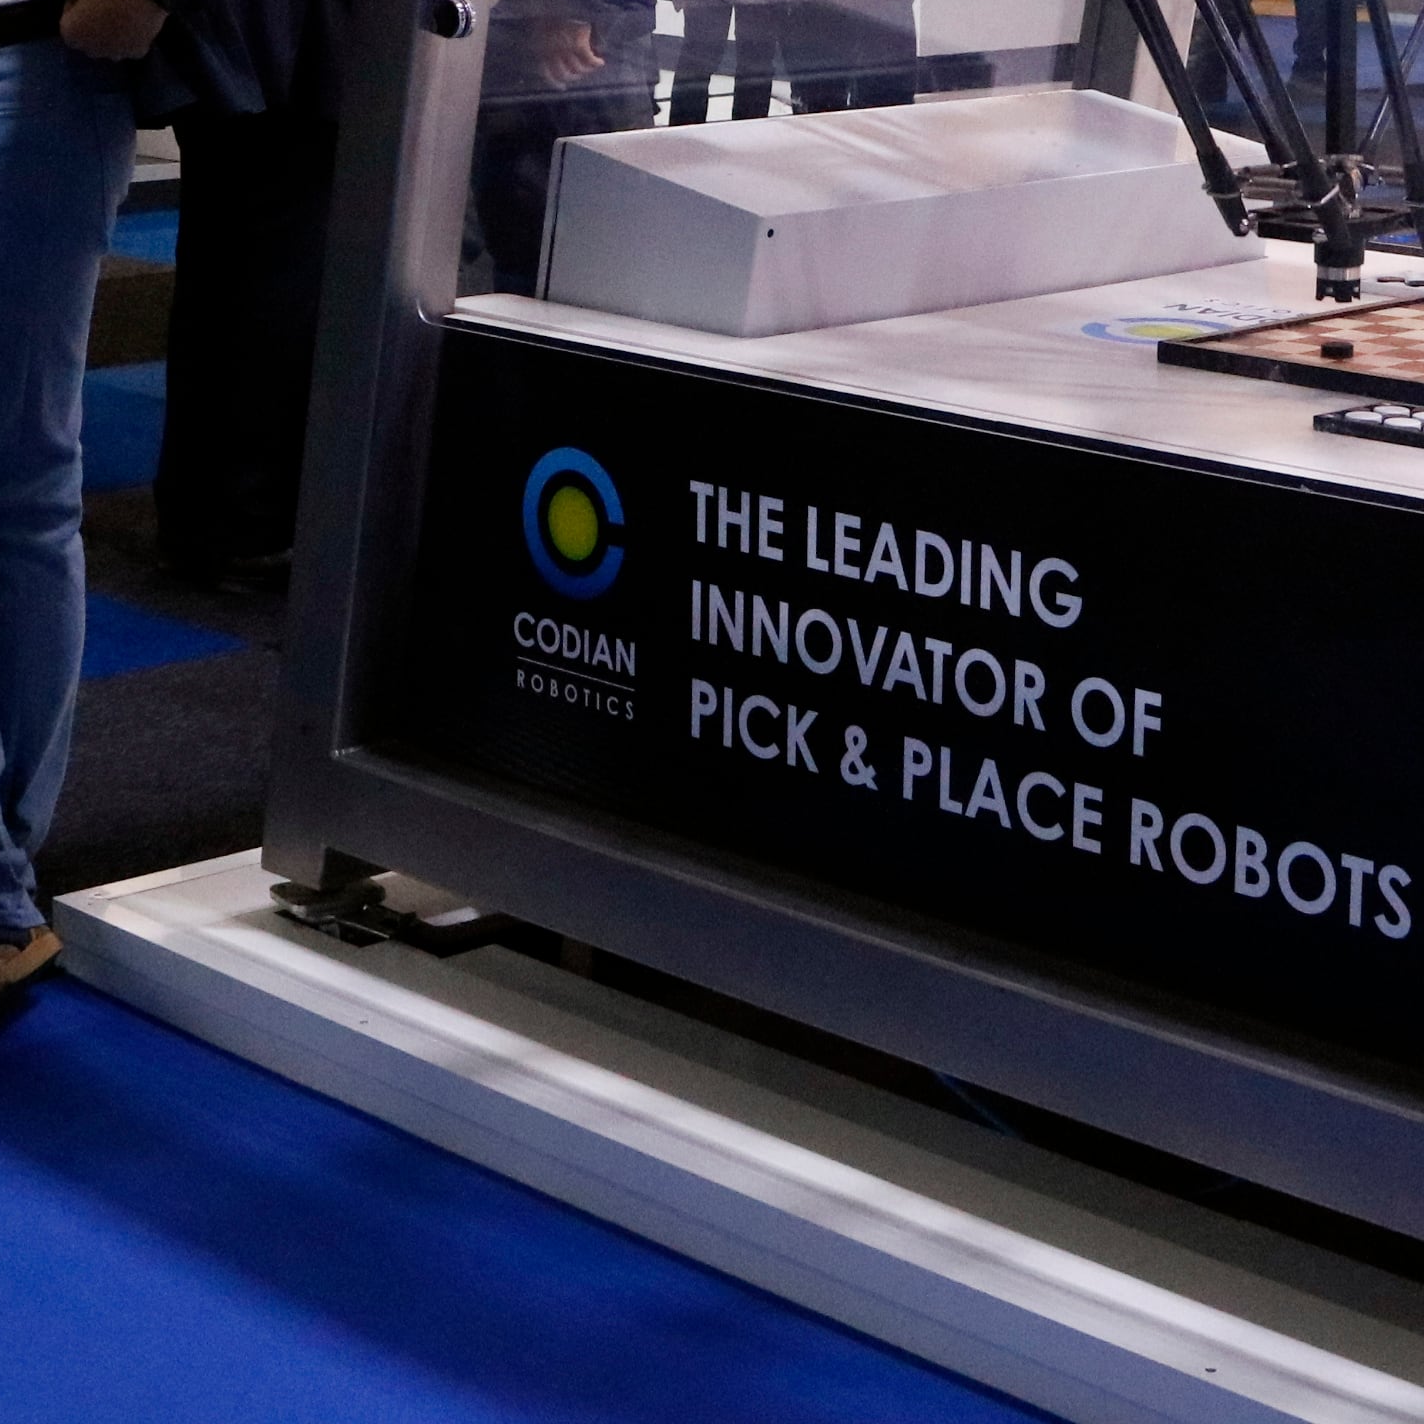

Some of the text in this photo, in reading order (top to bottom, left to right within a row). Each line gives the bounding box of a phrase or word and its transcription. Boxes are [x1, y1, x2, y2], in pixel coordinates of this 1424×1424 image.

[689, 481, 1084, 629] THE LEADING
[513, 611, 636, 677] CODIAN
[517, 668, 635, 721] ROBOTICS
[691, 580, 1163, 757] INNOVATOR OF
[691, 678, 1413, 940] PICK & PLACE ROBOTS
